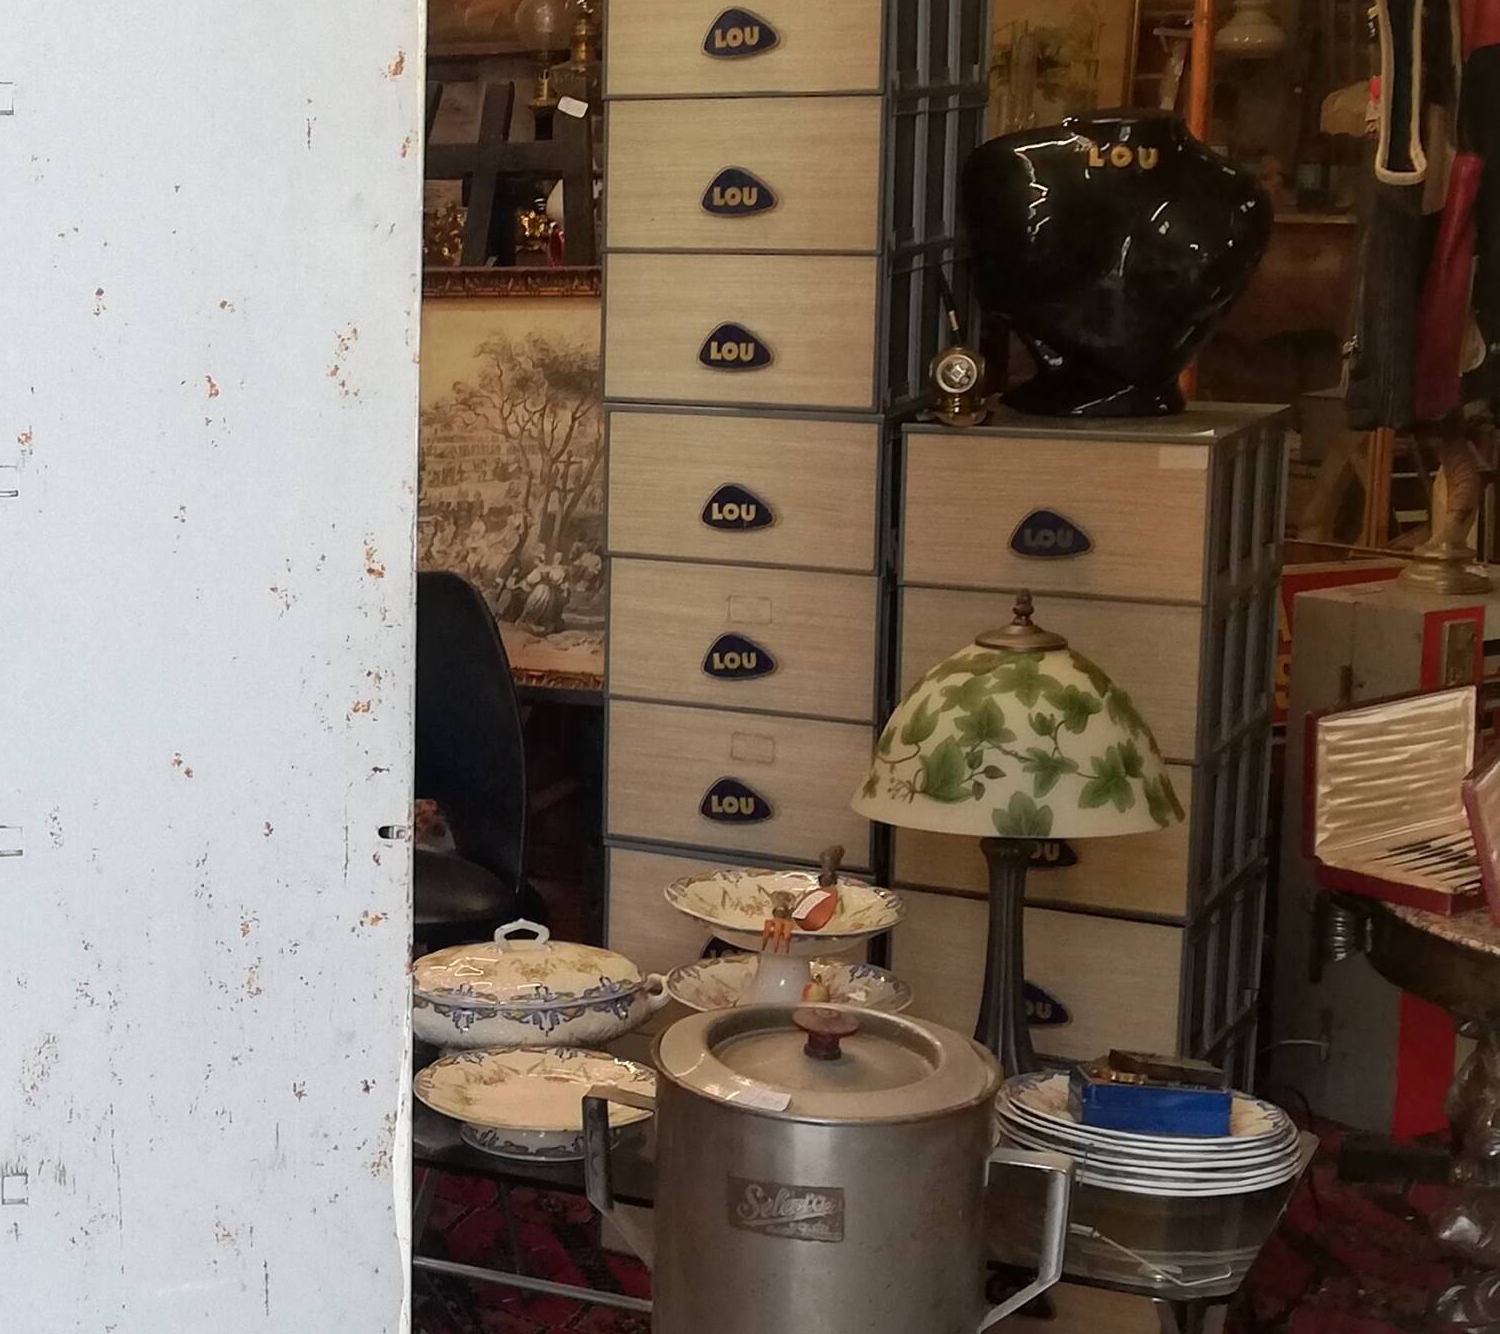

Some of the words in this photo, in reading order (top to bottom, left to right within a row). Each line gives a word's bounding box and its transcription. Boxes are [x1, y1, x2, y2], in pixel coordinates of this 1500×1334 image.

[713, 25, 760, 48] LOU
[1088, 143, 1159, 169] LOU
[711, 185, 759, 207] LOU
[709, 340, 756, 362] LOU
[711, 502, 757, 523] LOU
[1023, 528, 1074, 548] LOU
[713, 651, 758, 670] LOU
[711, 794, 756, 816] LOU
